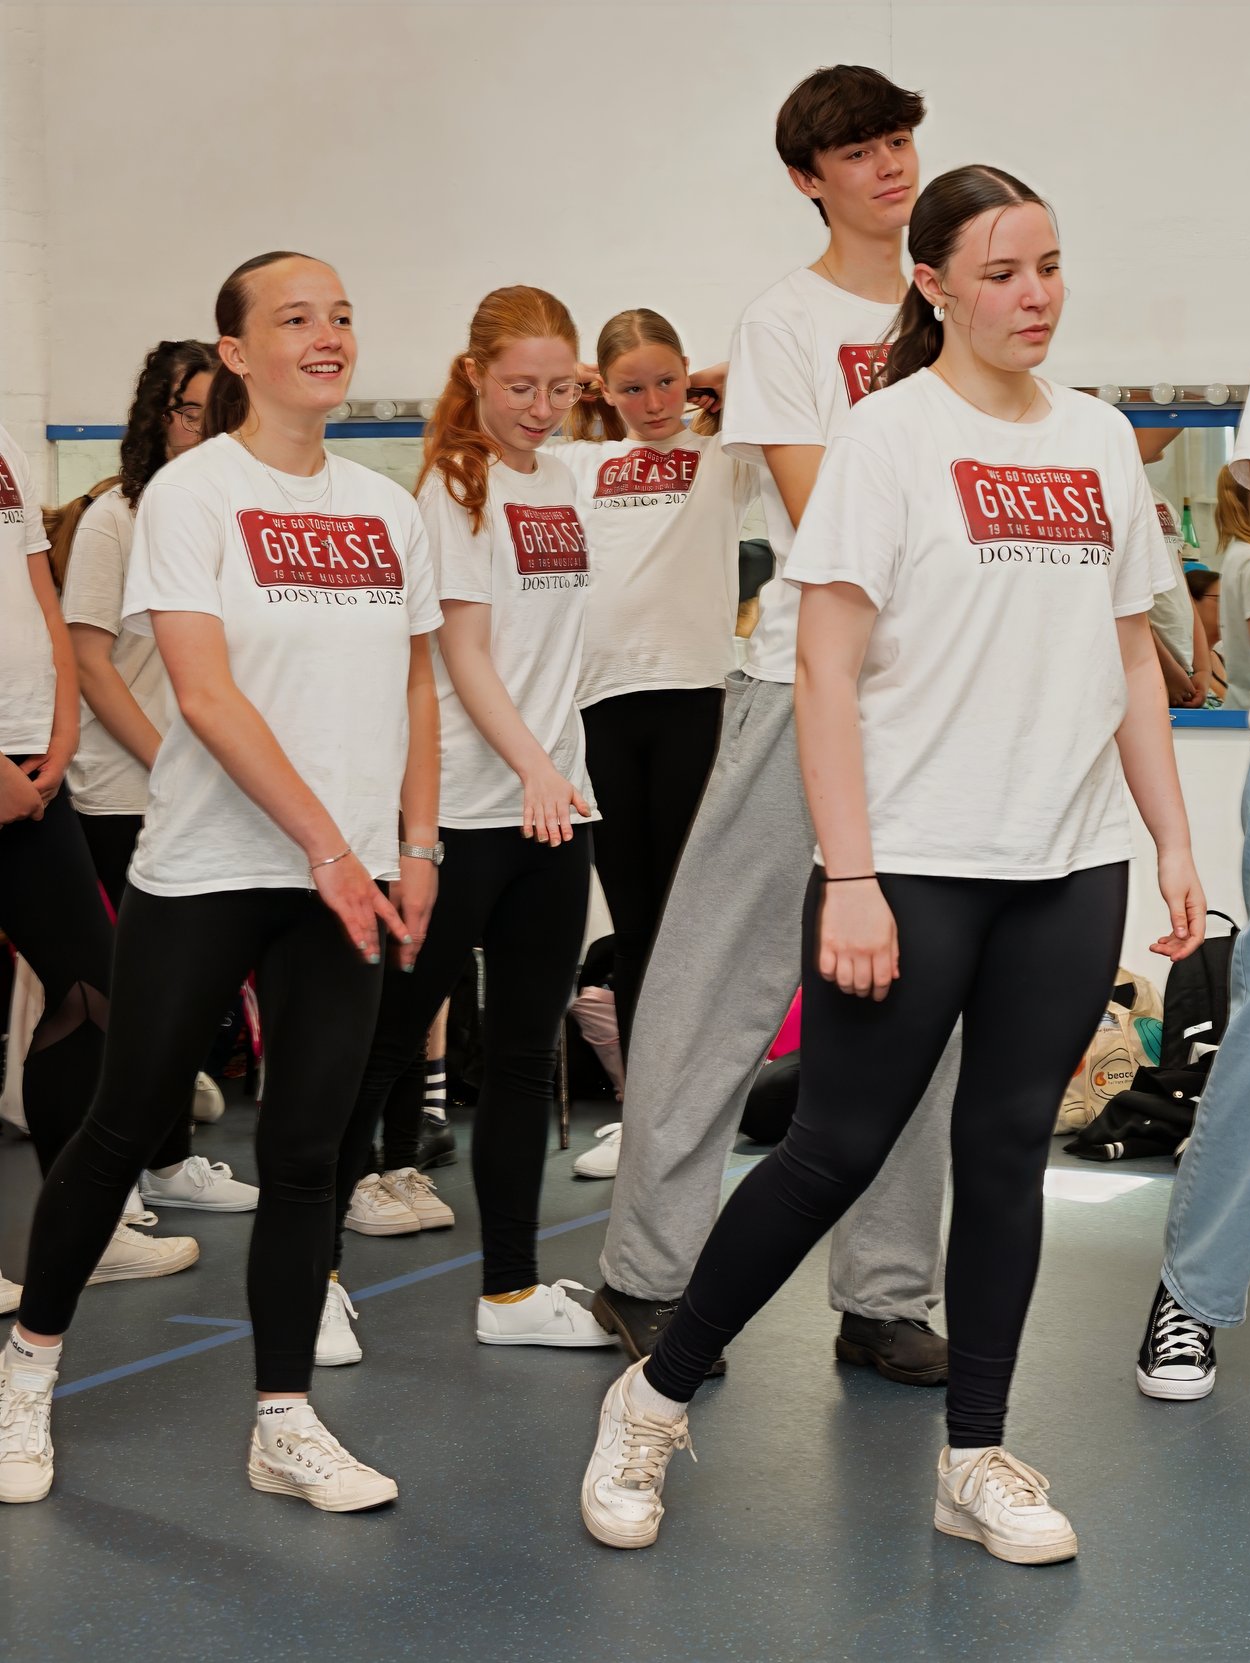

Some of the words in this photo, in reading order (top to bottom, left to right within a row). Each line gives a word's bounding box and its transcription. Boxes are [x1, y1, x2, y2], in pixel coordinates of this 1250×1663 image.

[603, 458, 693, 485] GREASE
[987, 469, 1002, 481] WE
[1006, 471, 1019, 482] GO
[1022, 472, 1073, 484] TOGETHER
[594, 496, 658, 509] DOSYTCo
[975, 479, 1107, 526] GREASE
[272, 518, 287, 529] WE
[290, 518, 305, 529] GO
[309, 518, 356, 532] TOGETHER
[988, 524, 1000, 535] 19
[1008, 524, 1031, 536] THE
[1038, 525, 1093, 539] MUSICAL
[519, 521, 588, 553] GREASE
[260, 528, 392, 569] GREASE
[979, 545, 1071, 565] DOSYTCo
[273, 569, 285, 579] 19
[290, 570, 313, 582] THE
[319, 574, 374, 584] MUSICAL
[385, 572, 396, 583] 59
[521, 575, 571, 590] DOSYTCo
[267, 588, 358, 606] DOSYTCo
[366, 590, 404, 606] 2025
